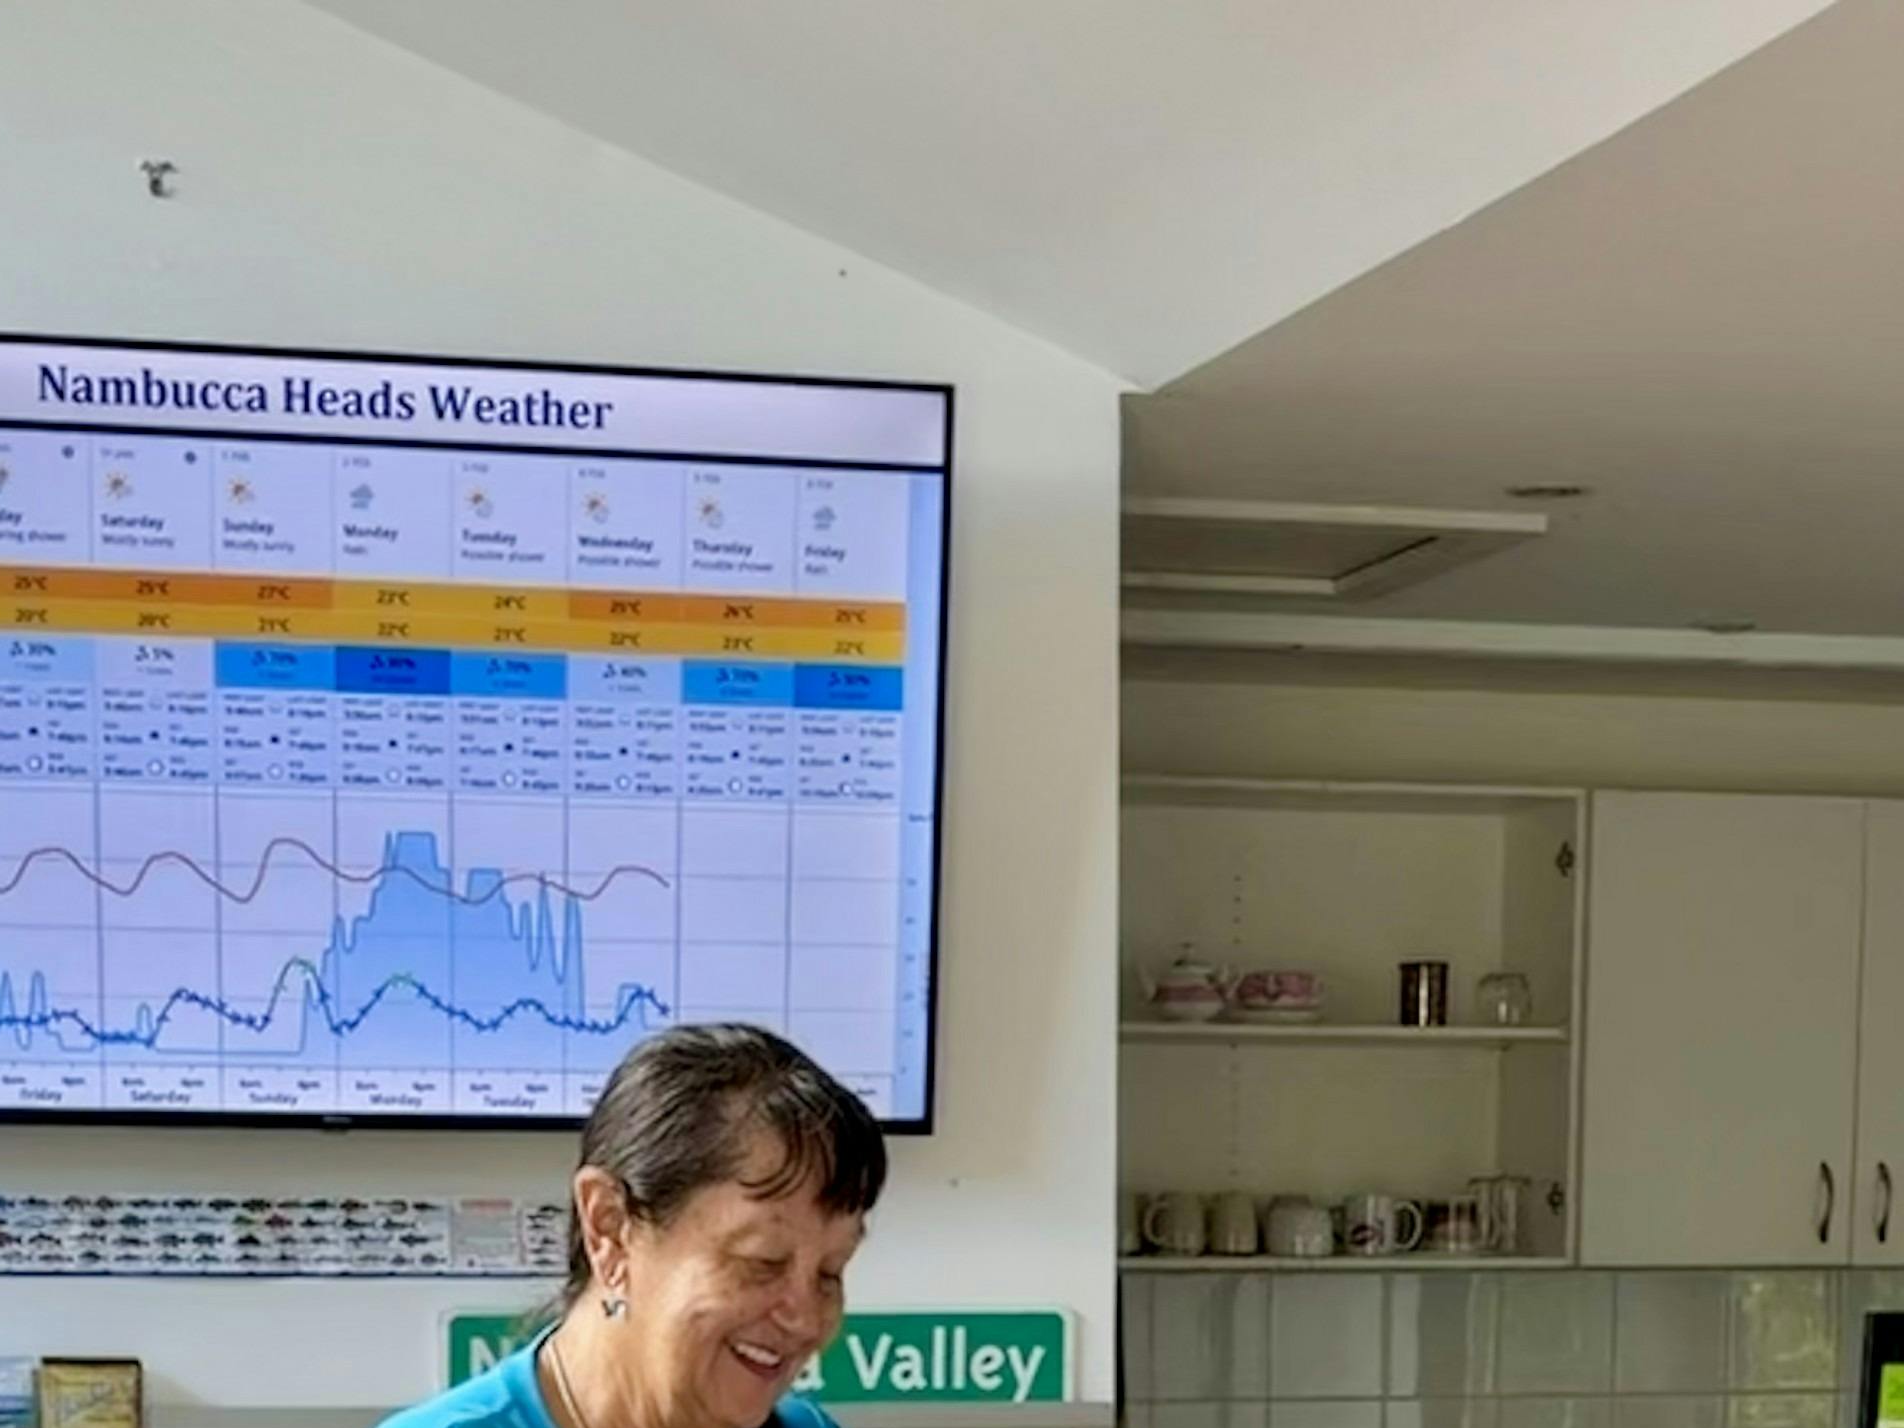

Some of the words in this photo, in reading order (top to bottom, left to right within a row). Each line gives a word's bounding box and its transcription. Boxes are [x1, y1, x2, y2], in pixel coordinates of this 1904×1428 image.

[39, 364, 267, 414] Nambucca
[296, 375, 415, 422] Heads
[428, 385, 614, 430] Weather
[100, 513, 166, 533] Saturday
[223, 518, 275, 537] Sunday
[343, 523, 399, 543] Monday
[461, 528, 518, 549] Tuesday
[578, 534, 654, 554] Wednesday
[692, 537, 753, 559] Thursday
[804, 543, 847, 565] Friday
[847, 1326, 1046, 1401] Valley
